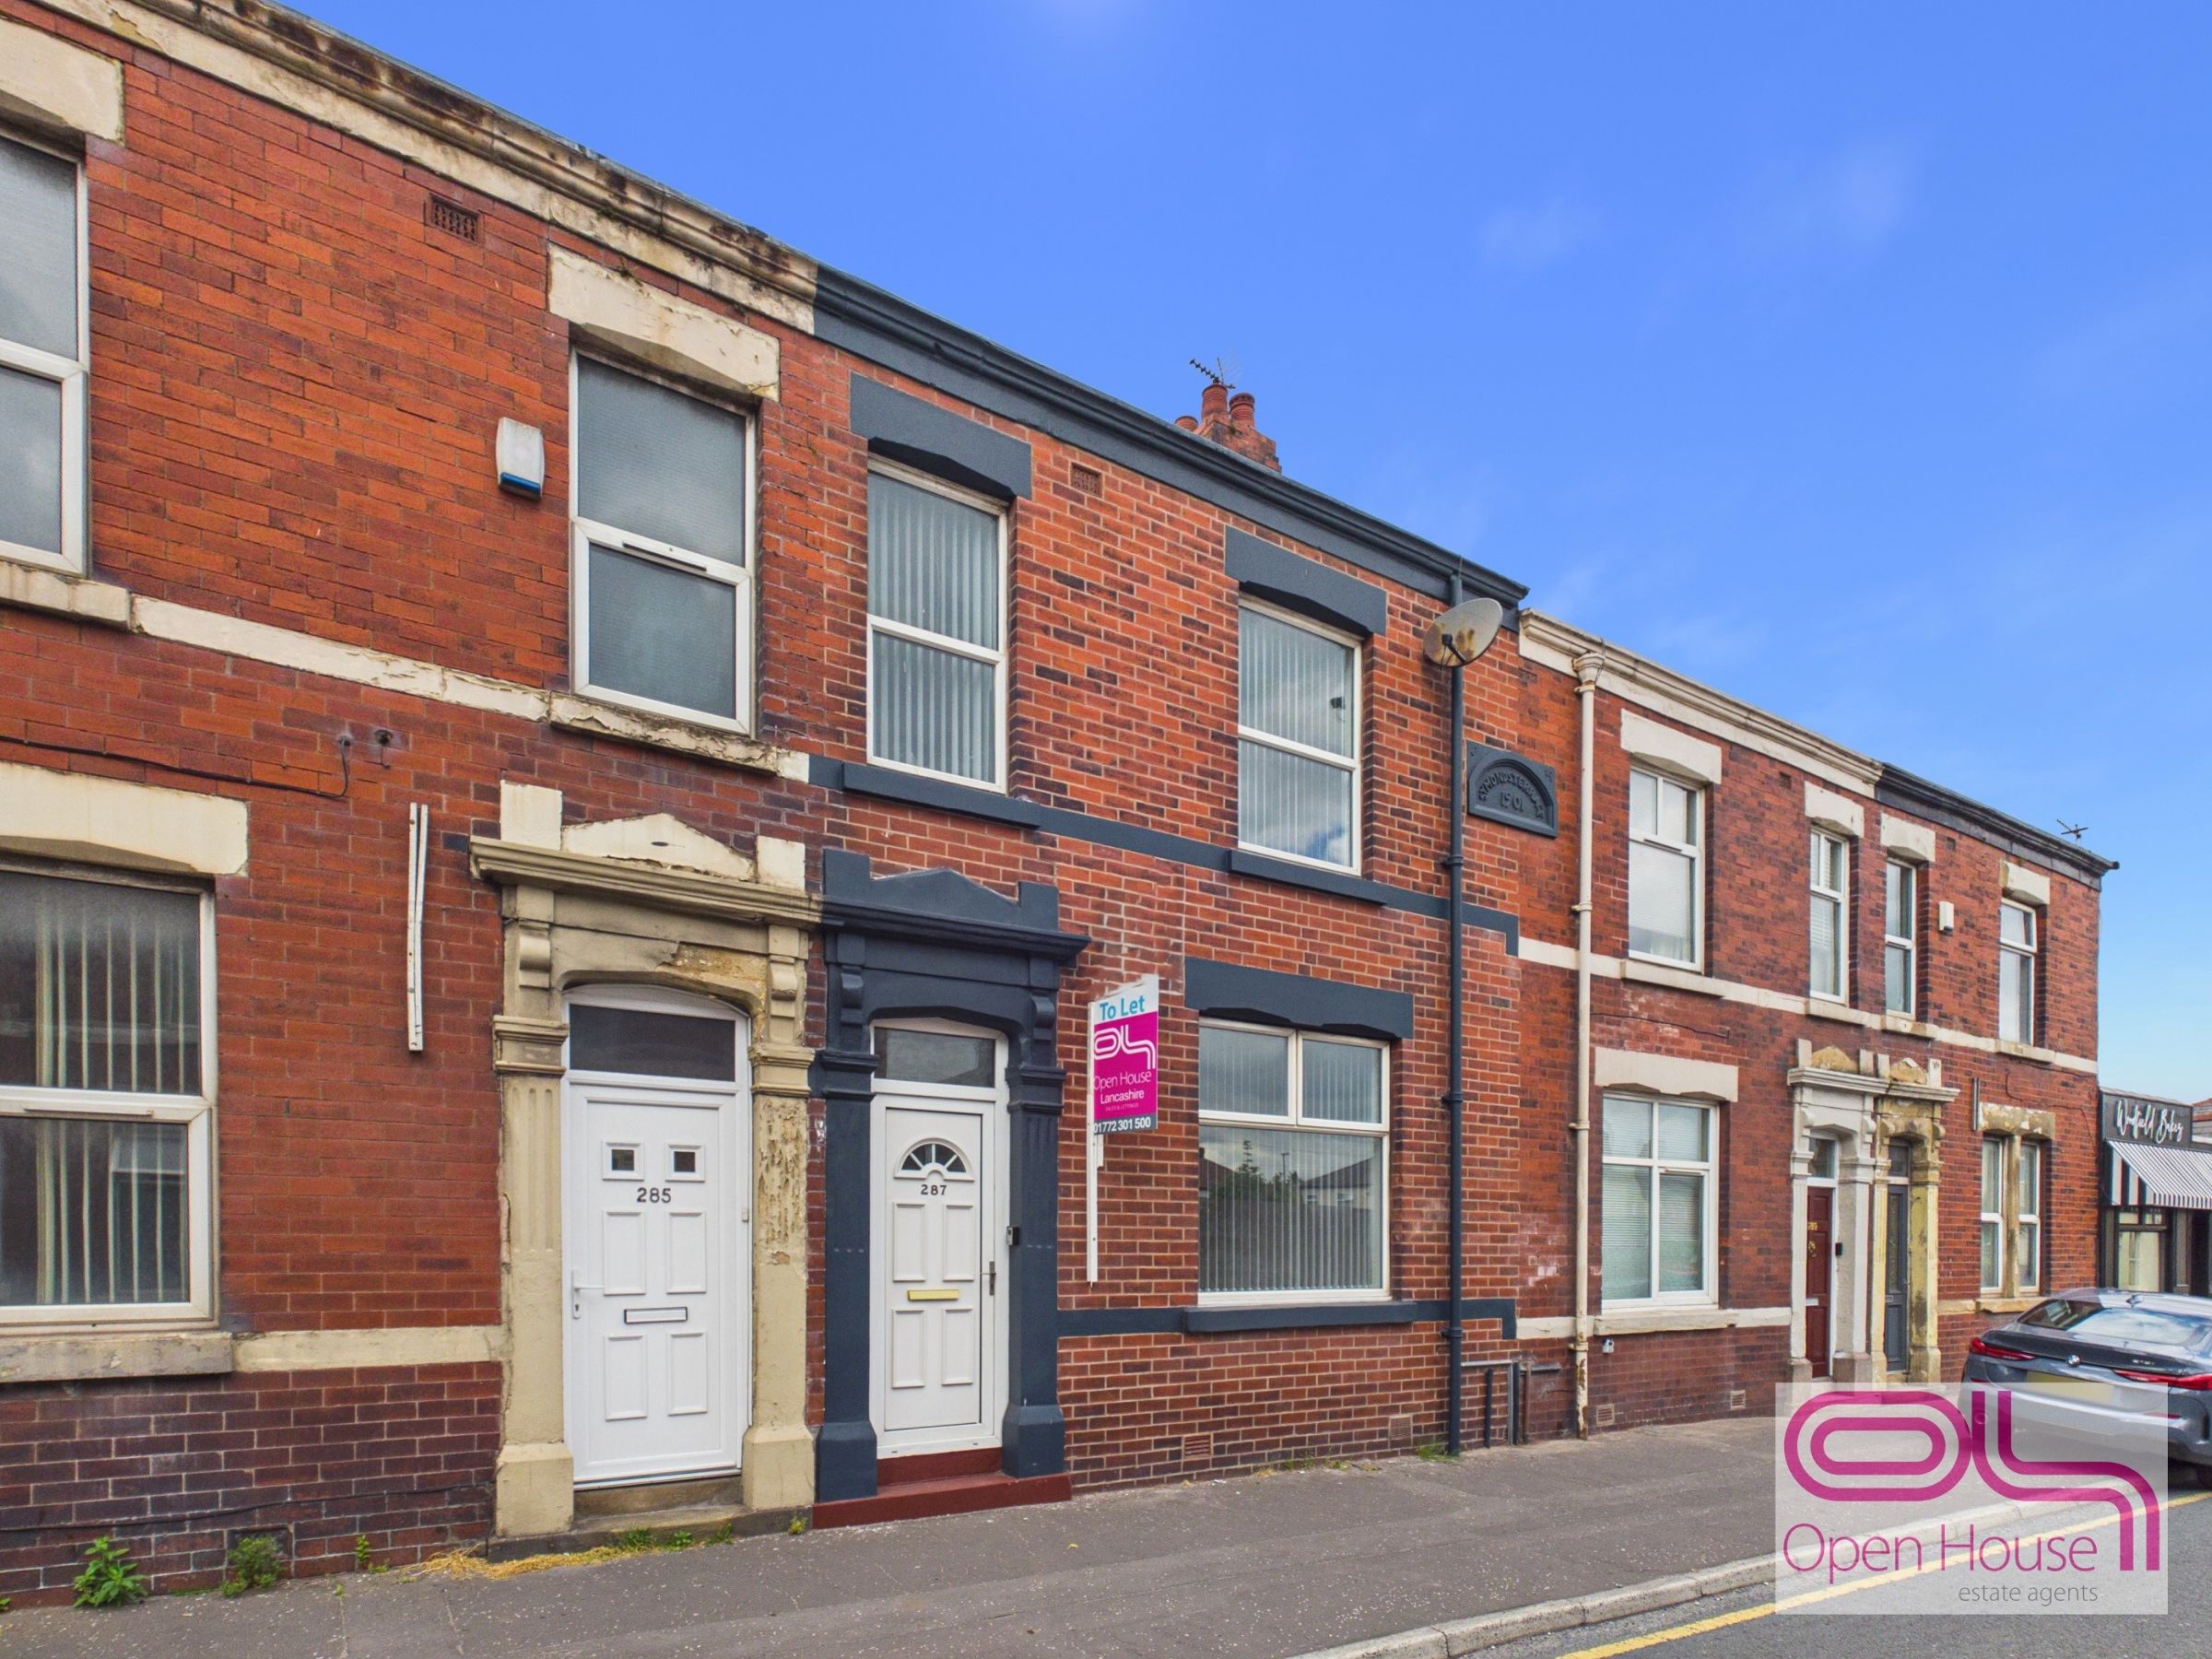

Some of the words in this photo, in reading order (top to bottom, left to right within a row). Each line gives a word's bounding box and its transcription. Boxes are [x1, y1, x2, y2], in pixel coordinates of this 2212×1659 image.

[1100, 1002, 1116, 1021] To
[1121, 995, 1146, 1016] Let
[1094, 1076, 1118, 1092] Open
[1120, 1071, 1152, 1086] House
[1100, 1088, 1145, 1104] Lancashire
[1094, 1121, 1117, 1133] 01772
[1118, 1119, 1134, 1130] 301
[1135, 1116, 1151, 1129] 500
[637, 1187, 671, 1203] 285
[921, 1184, 947, 1195] 287
